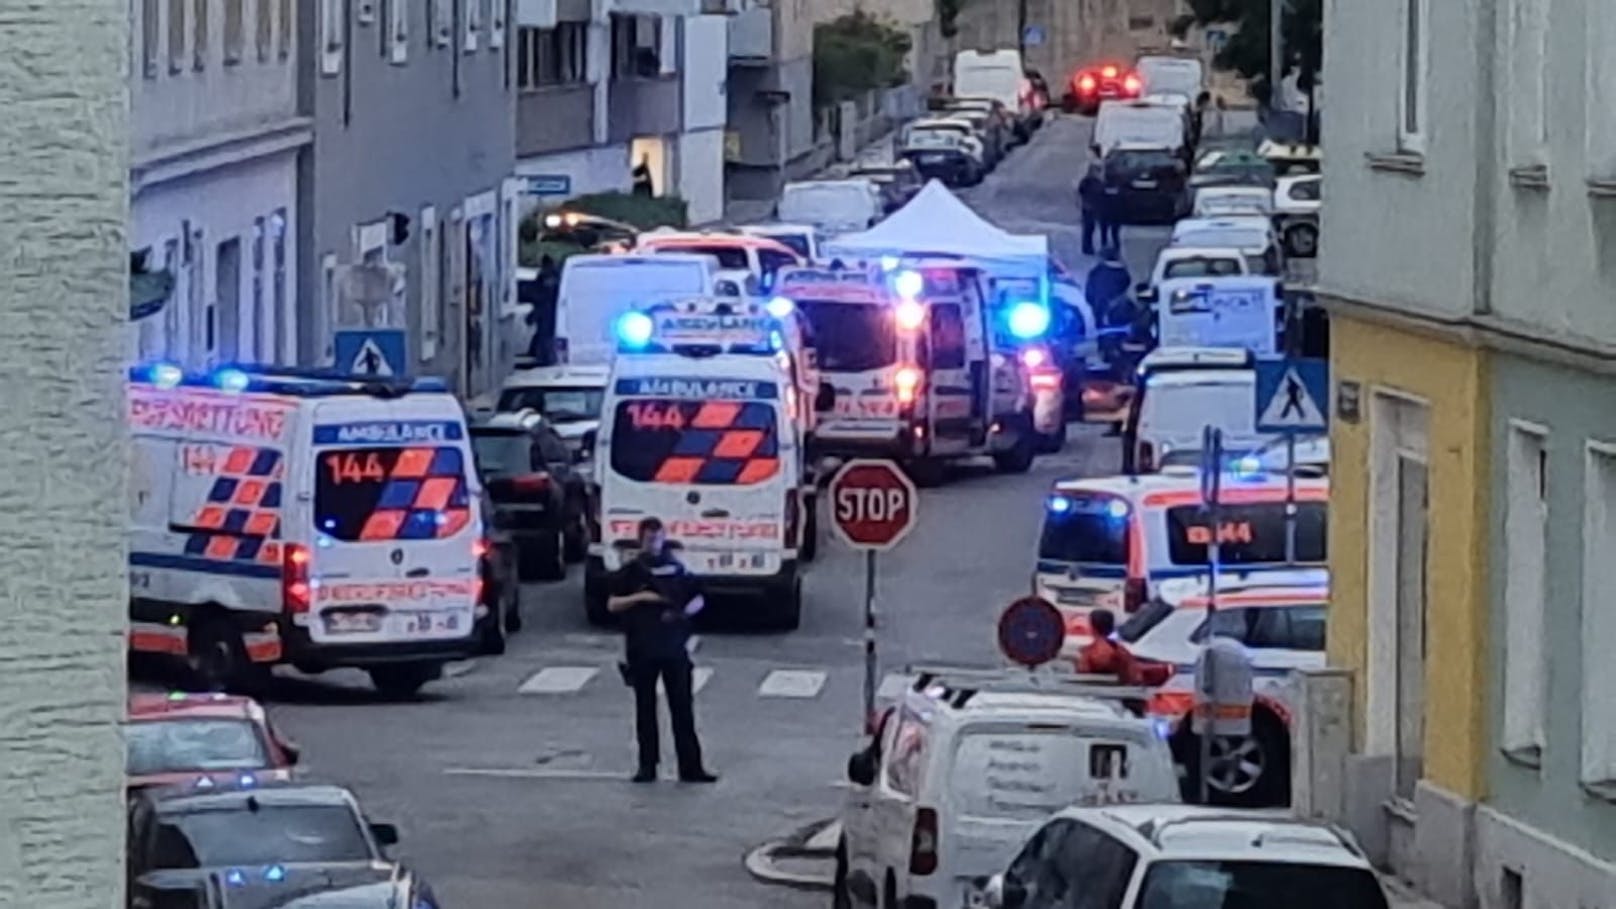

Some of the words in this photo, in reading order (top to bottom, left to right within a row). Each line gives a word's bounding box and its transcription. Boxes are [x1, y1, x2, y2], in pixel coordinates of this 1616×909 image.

[626, 403, 684, 430] 144
[326, 453, 385, 486] 144
[838, 488, 905, 522] STOP
